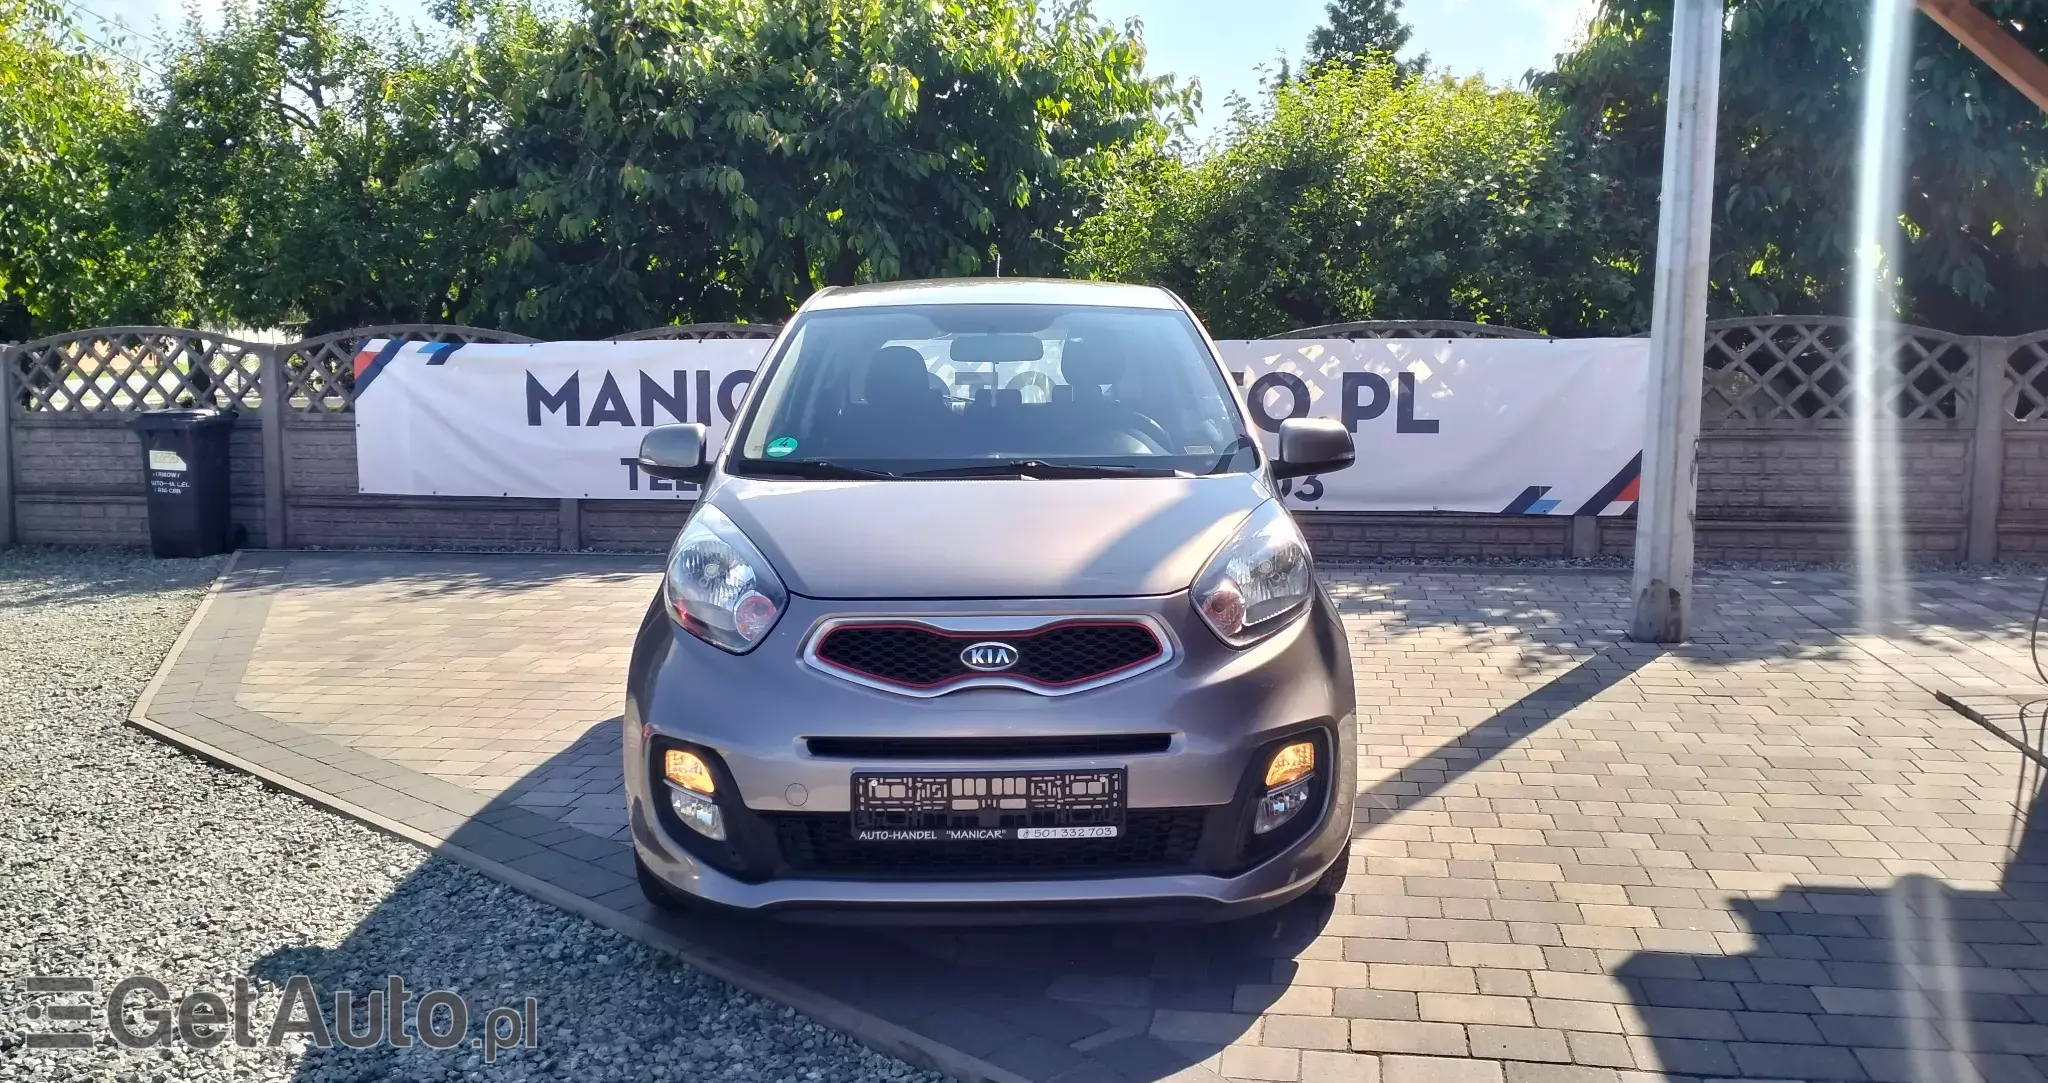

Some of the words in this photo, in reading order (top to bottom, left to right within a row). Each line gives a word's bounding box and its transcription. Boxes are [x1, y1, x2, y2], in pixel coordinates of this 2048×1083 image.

[971, 648, 1010, 664] KIA
[858, 830, 938, 841] AUTO-HANDEL
[946, 829, 1007, 840] "MANICAR"
[1034, 829, 1057, 838] 501
[1061, 828, 1085, 838] 332
[1088, 827, 1112, 836] 703
